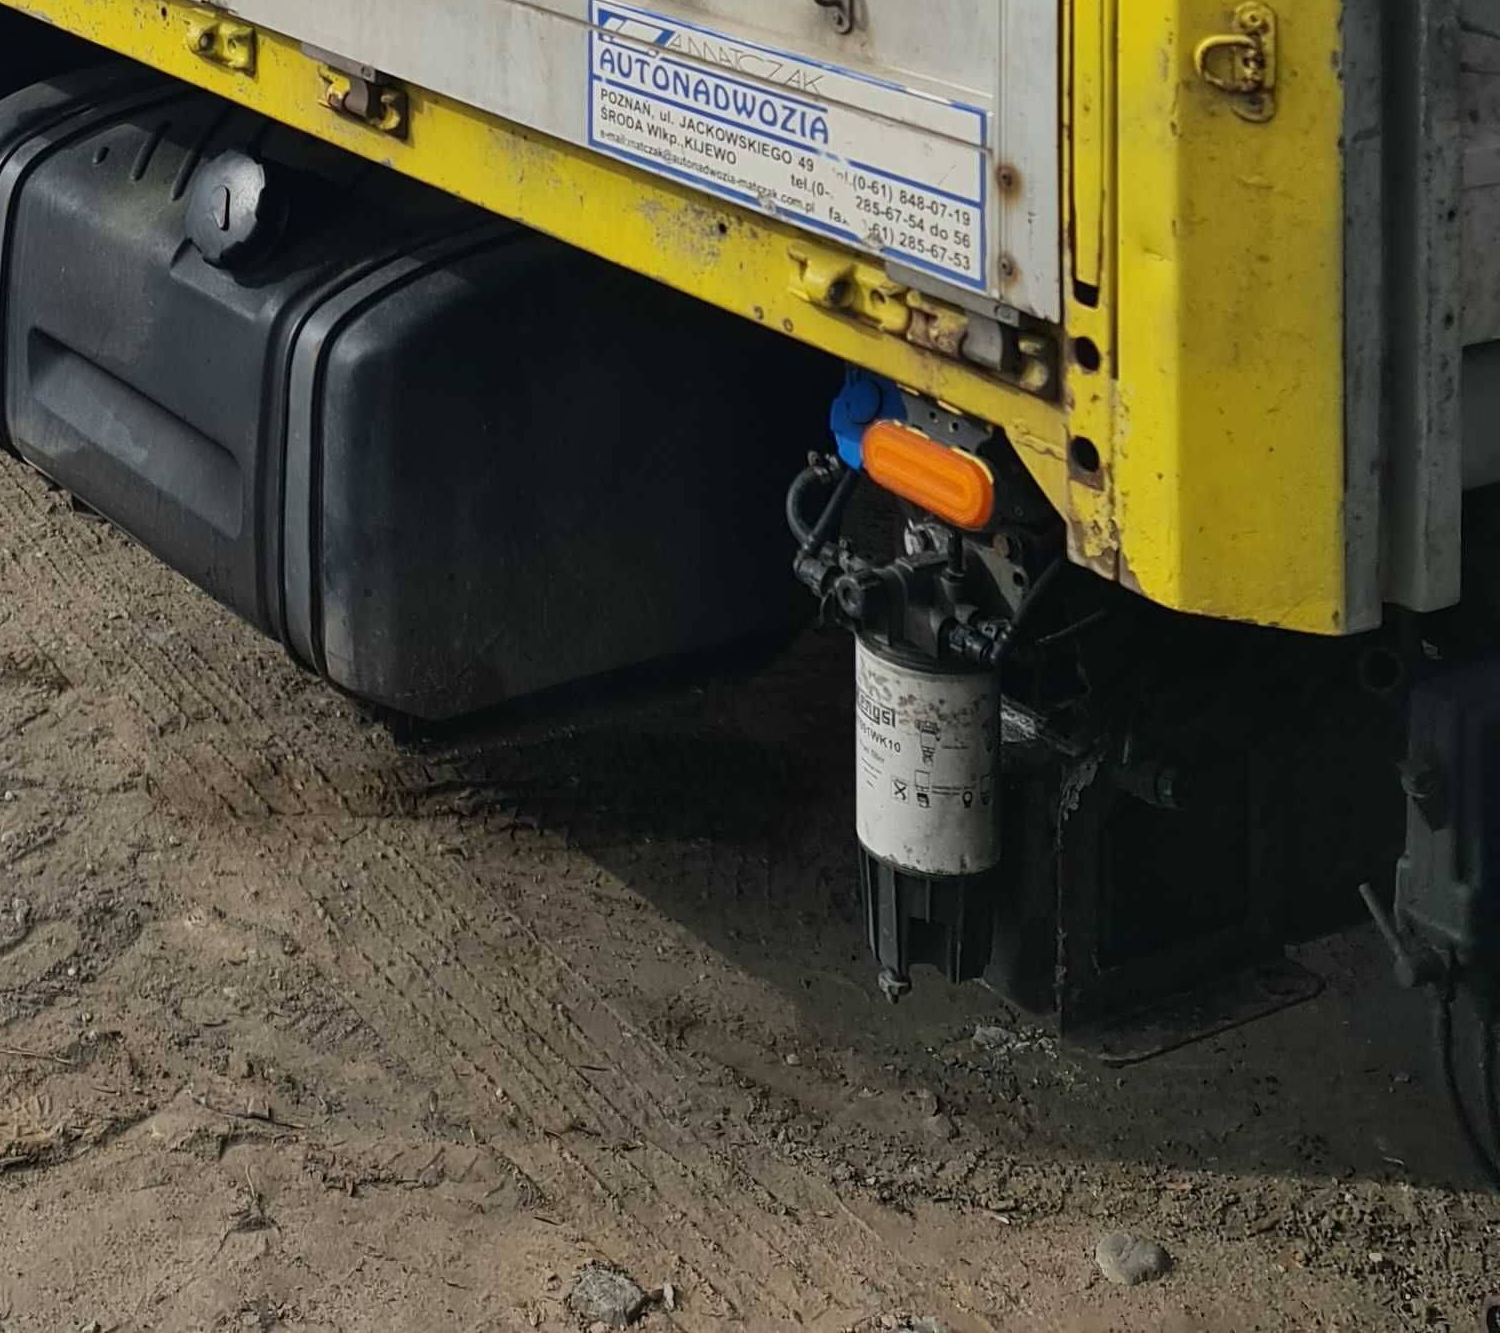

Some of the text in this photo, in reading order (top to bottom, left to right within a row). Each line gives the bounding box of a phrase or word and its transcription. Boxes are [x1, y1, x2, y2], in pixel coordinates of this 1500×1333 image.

[599, 47, 829, 145] AUTONADWOZIA
[600, 106, 644, 132] ŚRODA
[855, 195, 925, 232] 285-67-54
[929, 222, 949, 242] do
[953, 233, 971, 249] 56
[659, 110, 675, 126] ul.
[678, 113, 793, 165] JACKOWSKIEGO
[797, 156, 815, 173] 49
[899, 190, 971, 227] 848-07-19
[899, 232, 971, 271] 285-67-53
